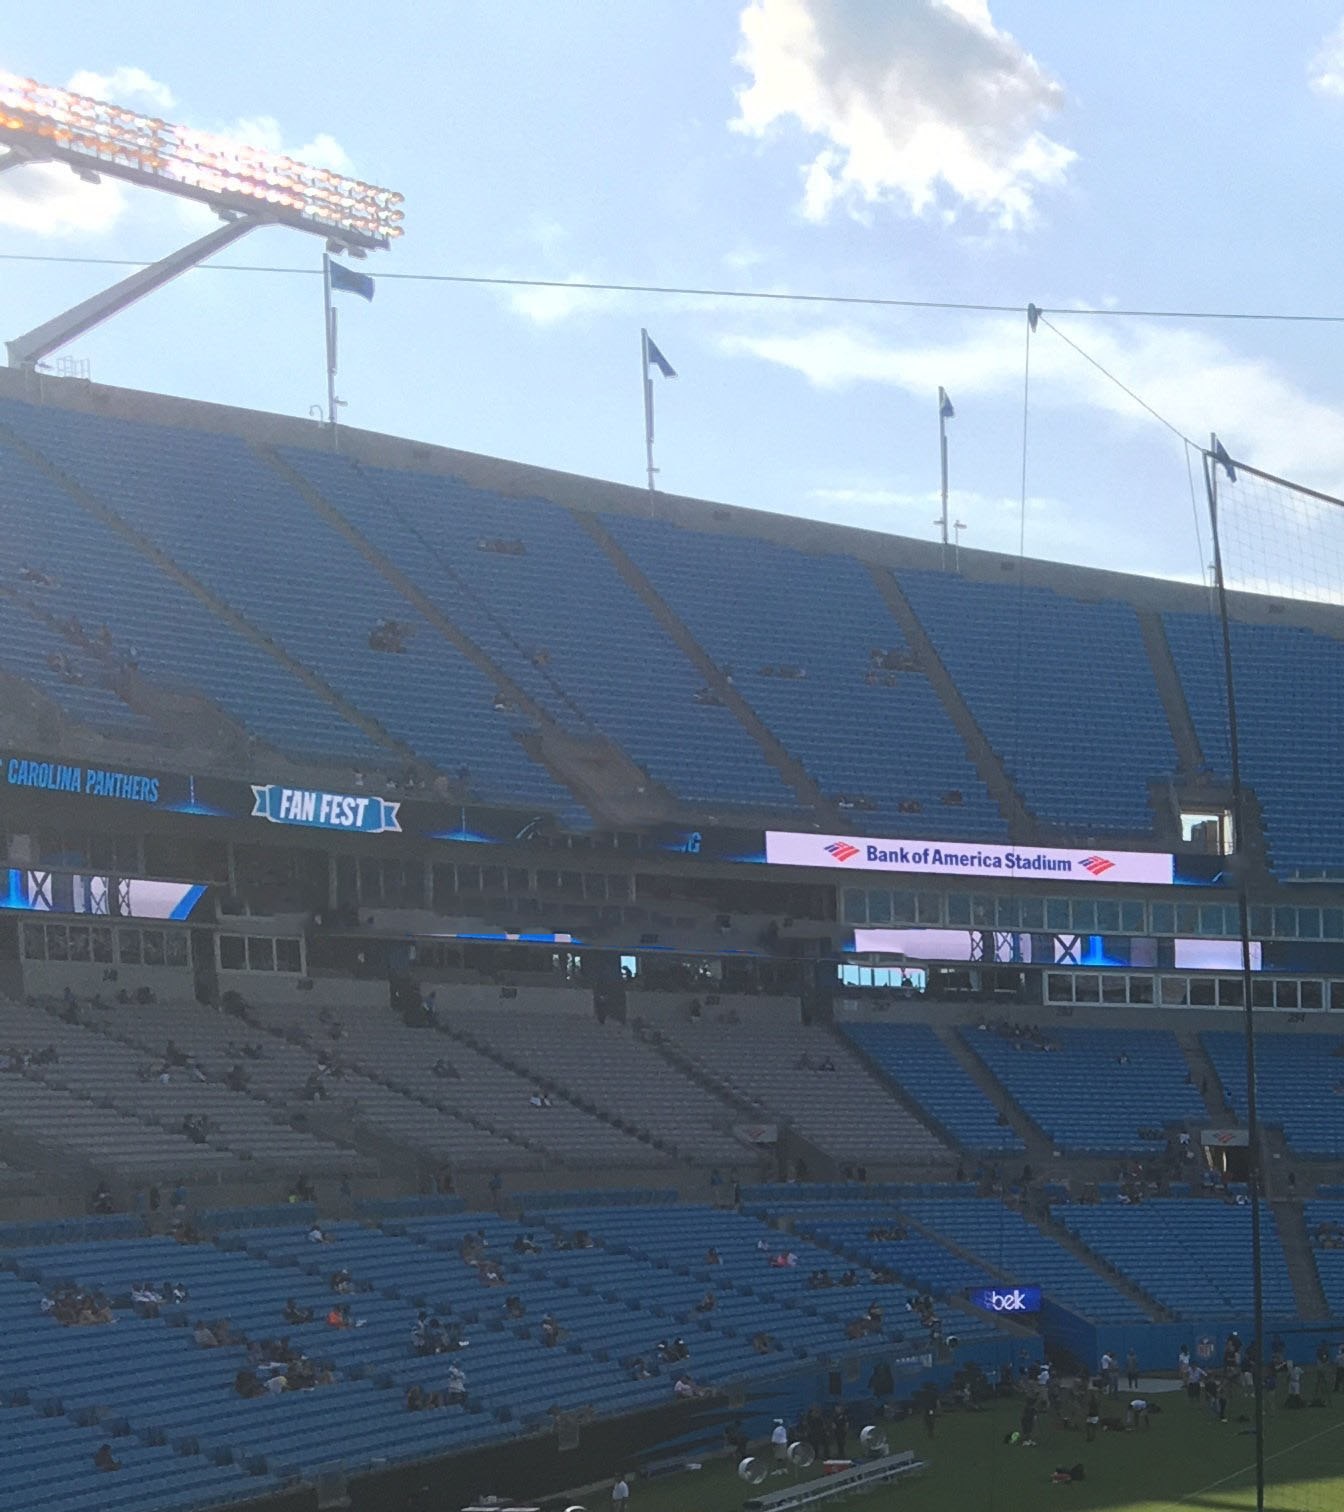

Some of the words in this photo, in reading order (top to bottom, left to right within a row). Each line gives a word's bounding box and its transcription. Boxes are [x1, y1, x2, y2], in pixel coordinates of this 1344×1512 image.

[7, 758, 81, 793] CAROLINA
[85, 768, 160, 803] PANTHERS
[279, 788, 316, 821] FAN
[319, 792, 369, 828] FEST
[866, 845, 910, 865] Bank
[911, 847, 930, 865] of
[931, 846, 1001, 869] America
[1004, 849, 1072, 872] Stadium
